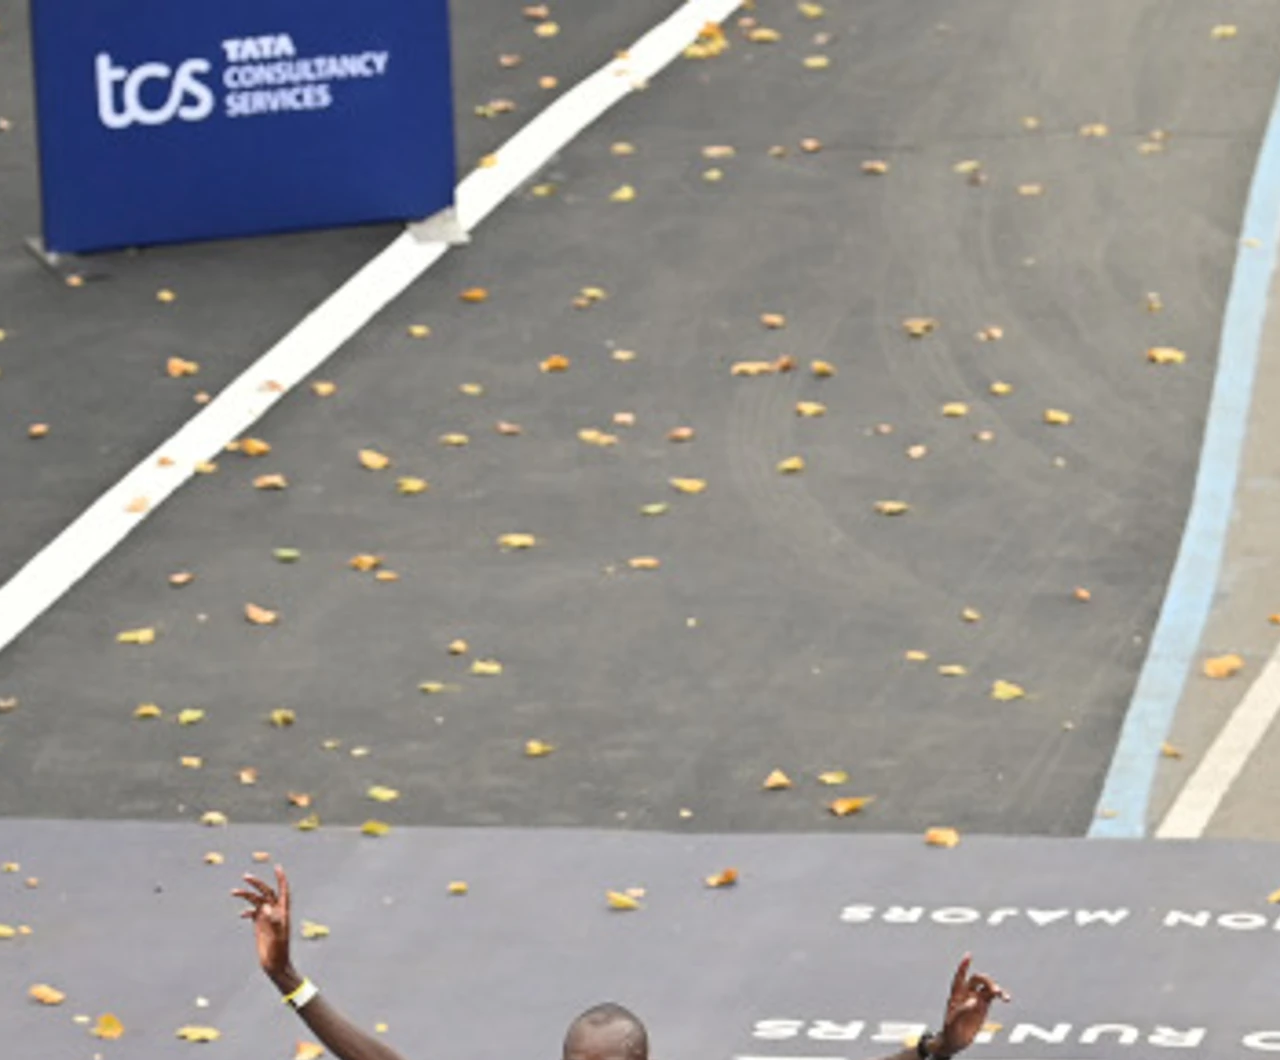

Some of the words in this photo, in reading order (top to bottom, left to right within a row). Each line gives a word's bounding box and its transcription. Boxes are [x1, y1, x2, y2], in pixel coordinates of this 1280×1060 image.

[222, 33, 296, 62] TATA
[223, 51, 389, 88] CONSULTANCY
[95, 53, 216, 129] tcs
[224, 84, 333, 117] SERVICES
[840, 905, 1129, 927] MAJORS
